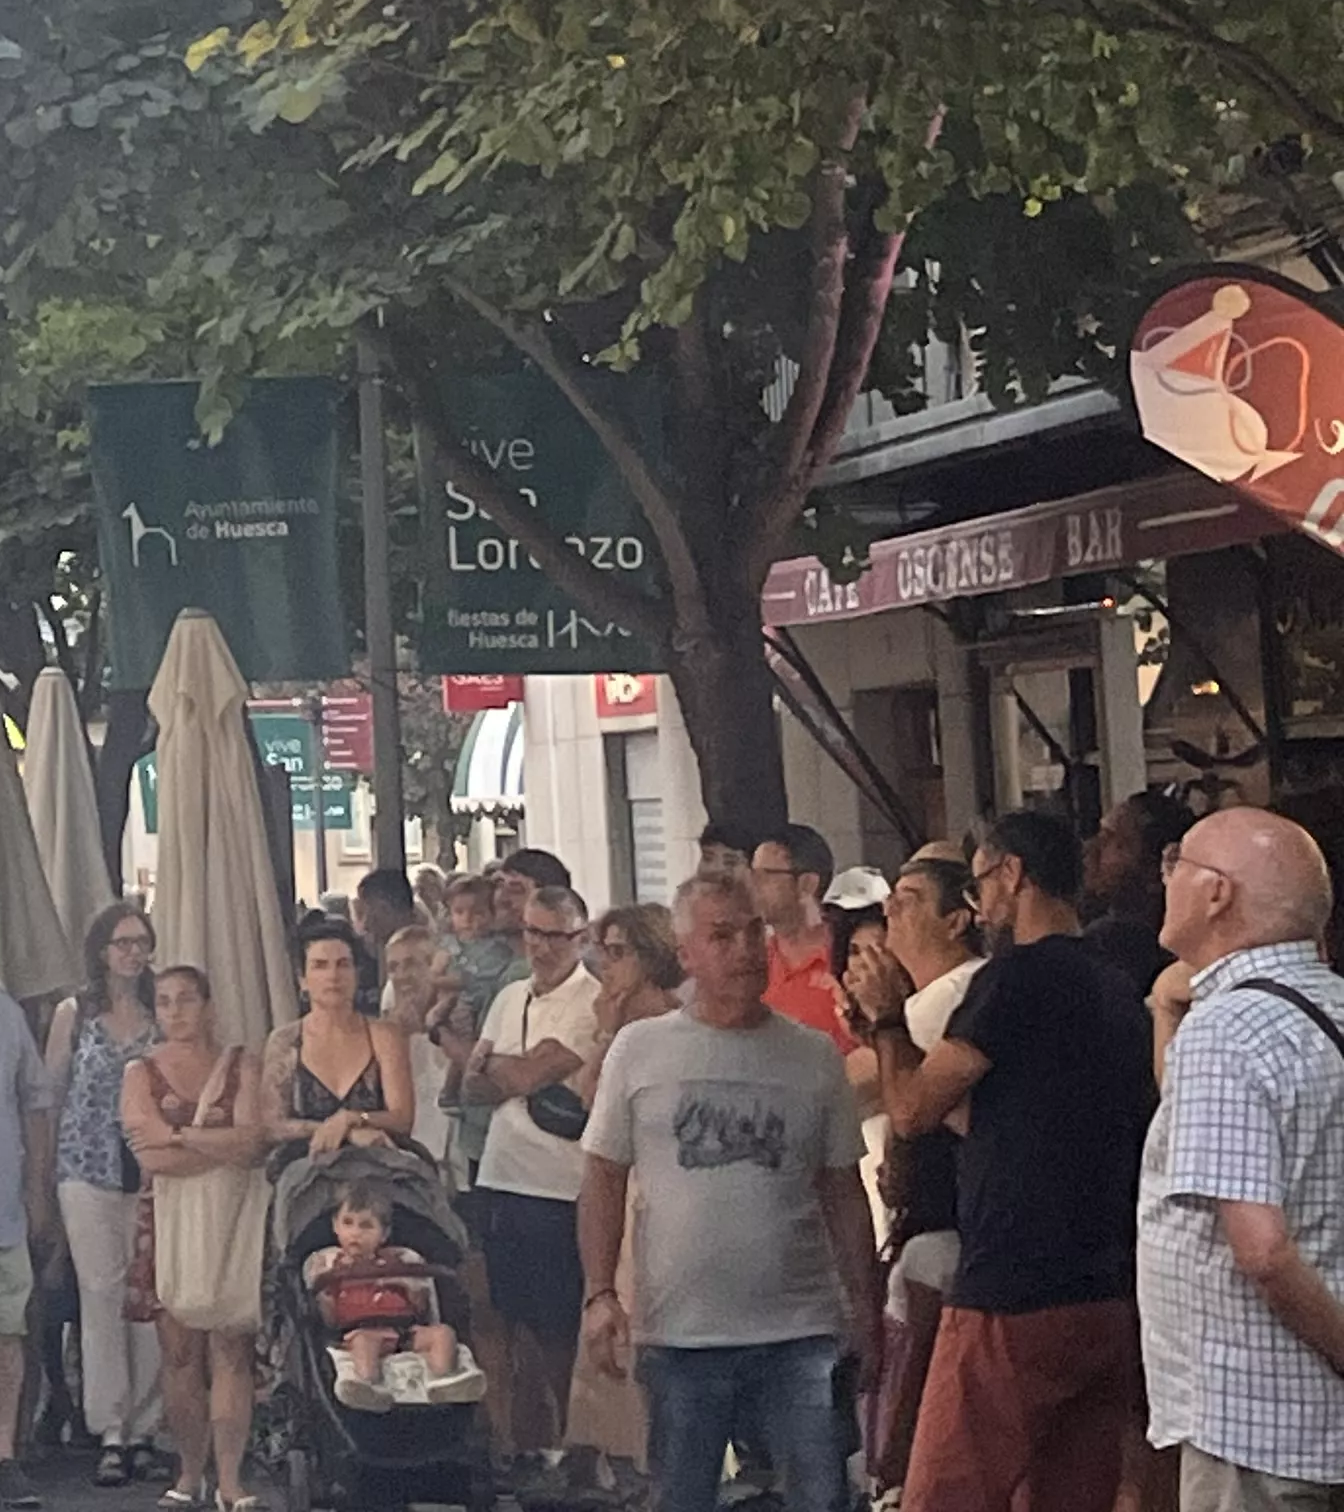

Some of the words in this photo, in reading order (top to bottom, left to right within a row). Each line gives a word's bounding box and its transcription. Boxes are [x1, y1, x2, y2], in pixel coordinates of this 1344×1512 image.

[462, 426, 535, 471] ive
[185, 521, 210, 540] de
[214, 520, 289, 539] Huesca
[448, 525, 644, 571] Lorzo
[896, 531, 1014, 600] OSCENSE
[1066, 508, 1124, 567] BAR
[447, 608, 511, 628] fiestas
[515, 607, 539, 626] de
[468, 630, 539, 649] Huesca
